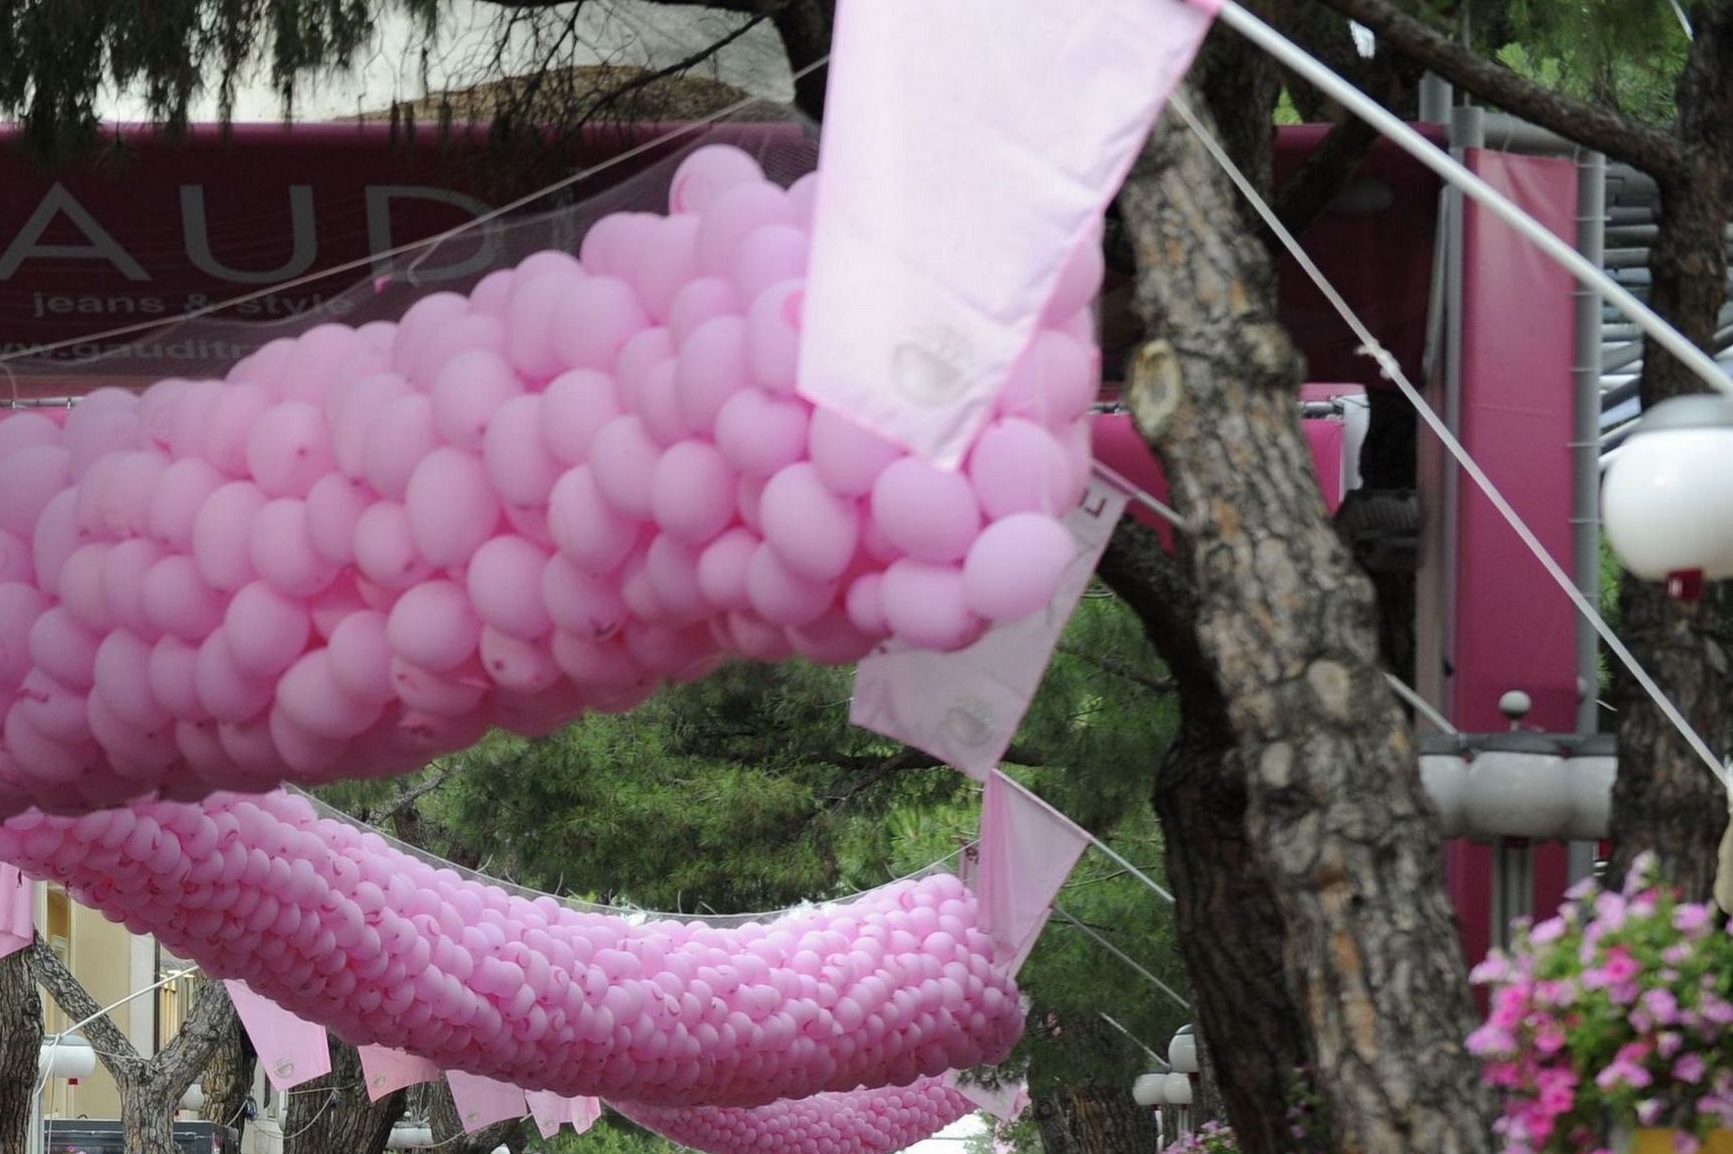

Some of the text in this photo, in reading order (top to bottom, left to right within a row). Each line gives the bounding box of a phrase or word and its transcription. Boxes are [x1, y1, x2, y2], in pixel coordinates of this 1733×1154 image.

[34, 291, 355, 317] jeans & style
